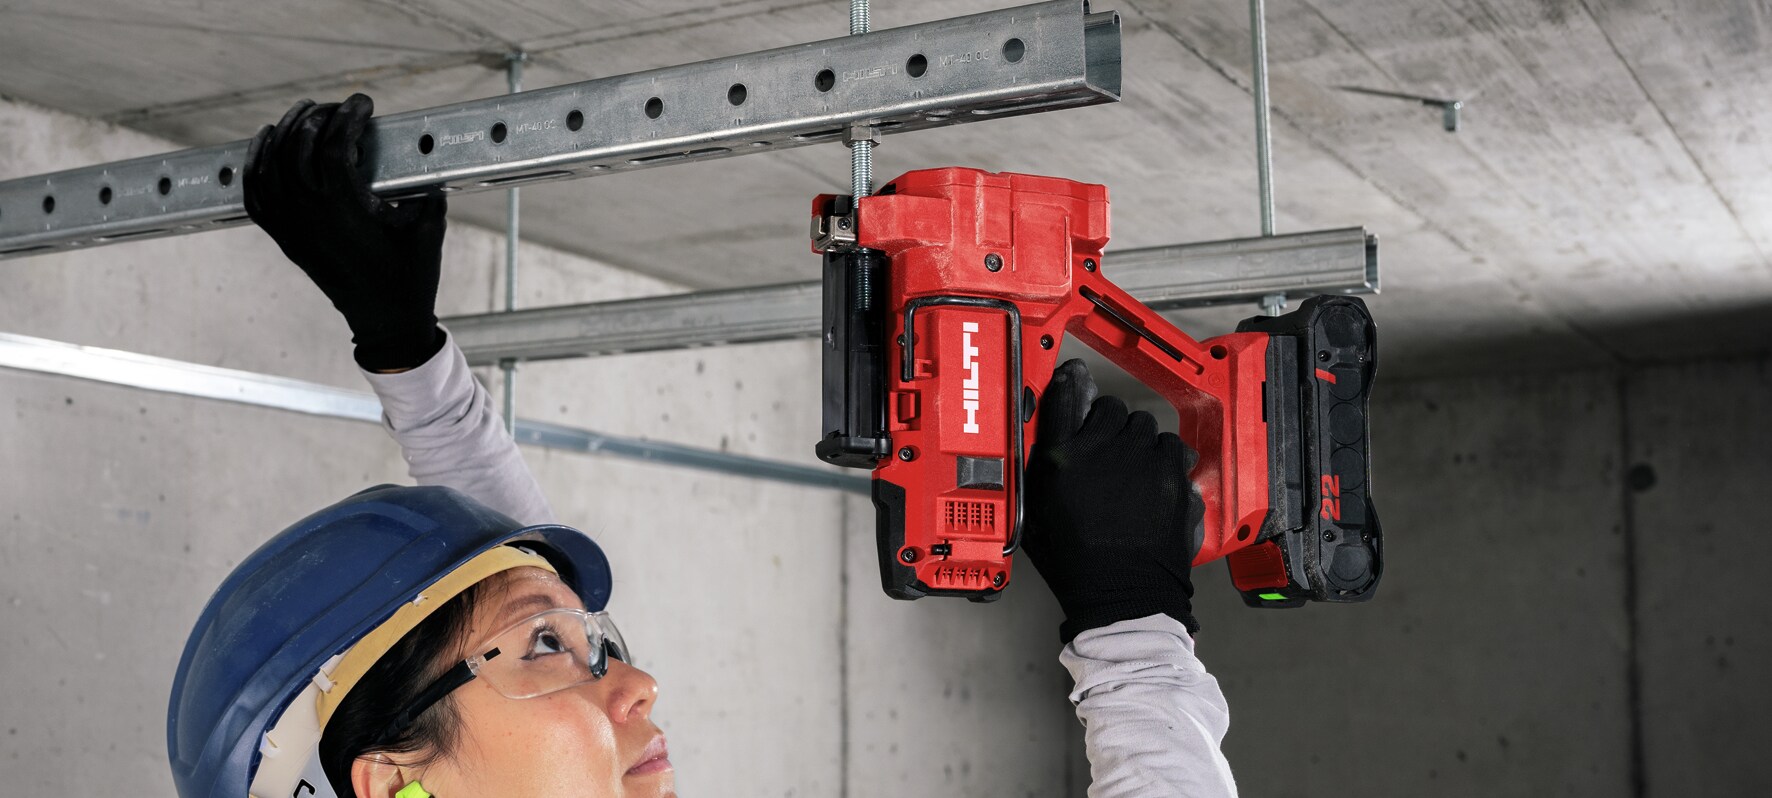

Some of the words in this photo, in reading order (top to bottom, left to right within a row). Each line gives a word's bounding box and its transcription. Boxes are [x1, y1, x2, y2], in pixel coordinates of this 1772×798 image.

[939, 51, 972, 68] MT-40
[516, 121, 542, 135] MT-40
[963, 322, 979, 434] HILTI
[1321, 474, 1341, 521] 22
